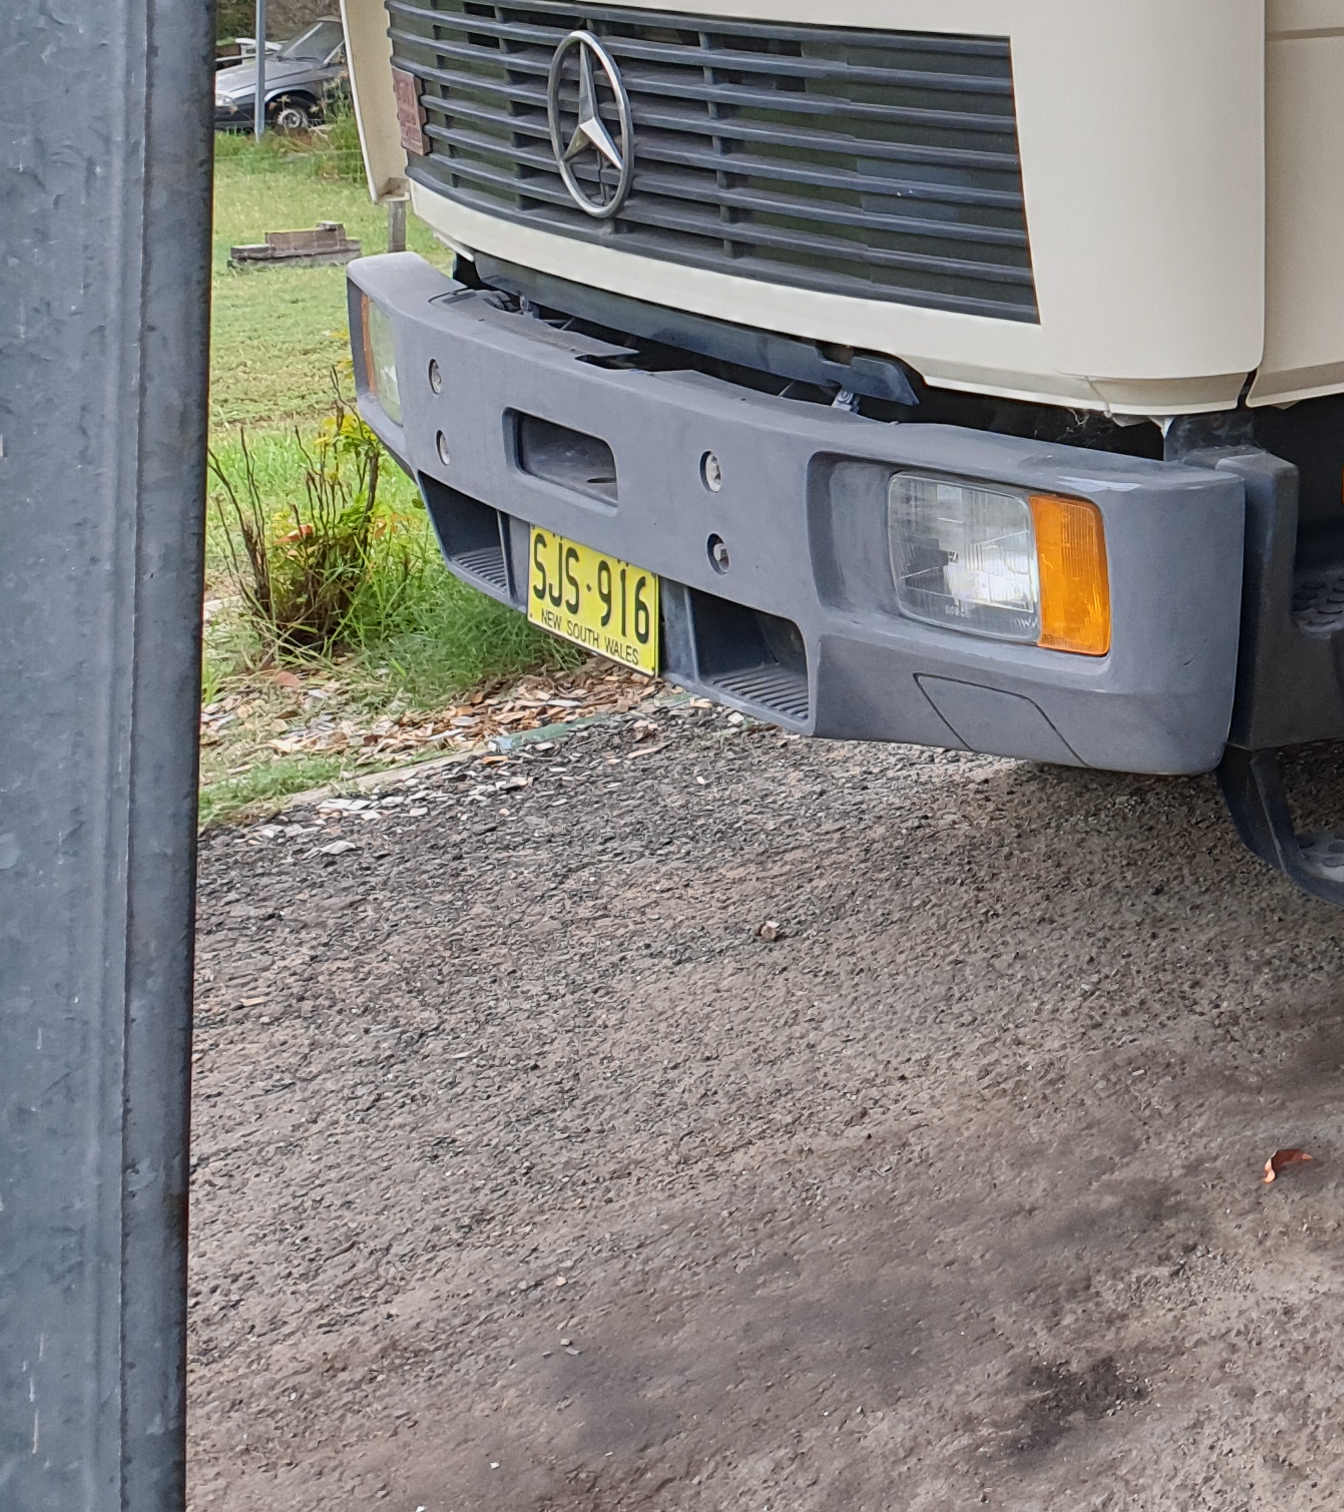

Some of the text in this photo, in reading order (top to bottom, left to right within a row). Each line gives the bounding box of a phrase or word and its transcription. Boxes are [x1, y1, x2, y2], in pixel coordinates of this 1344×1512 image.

[540, 607, 640, 667] NEW SOUTH WALES
